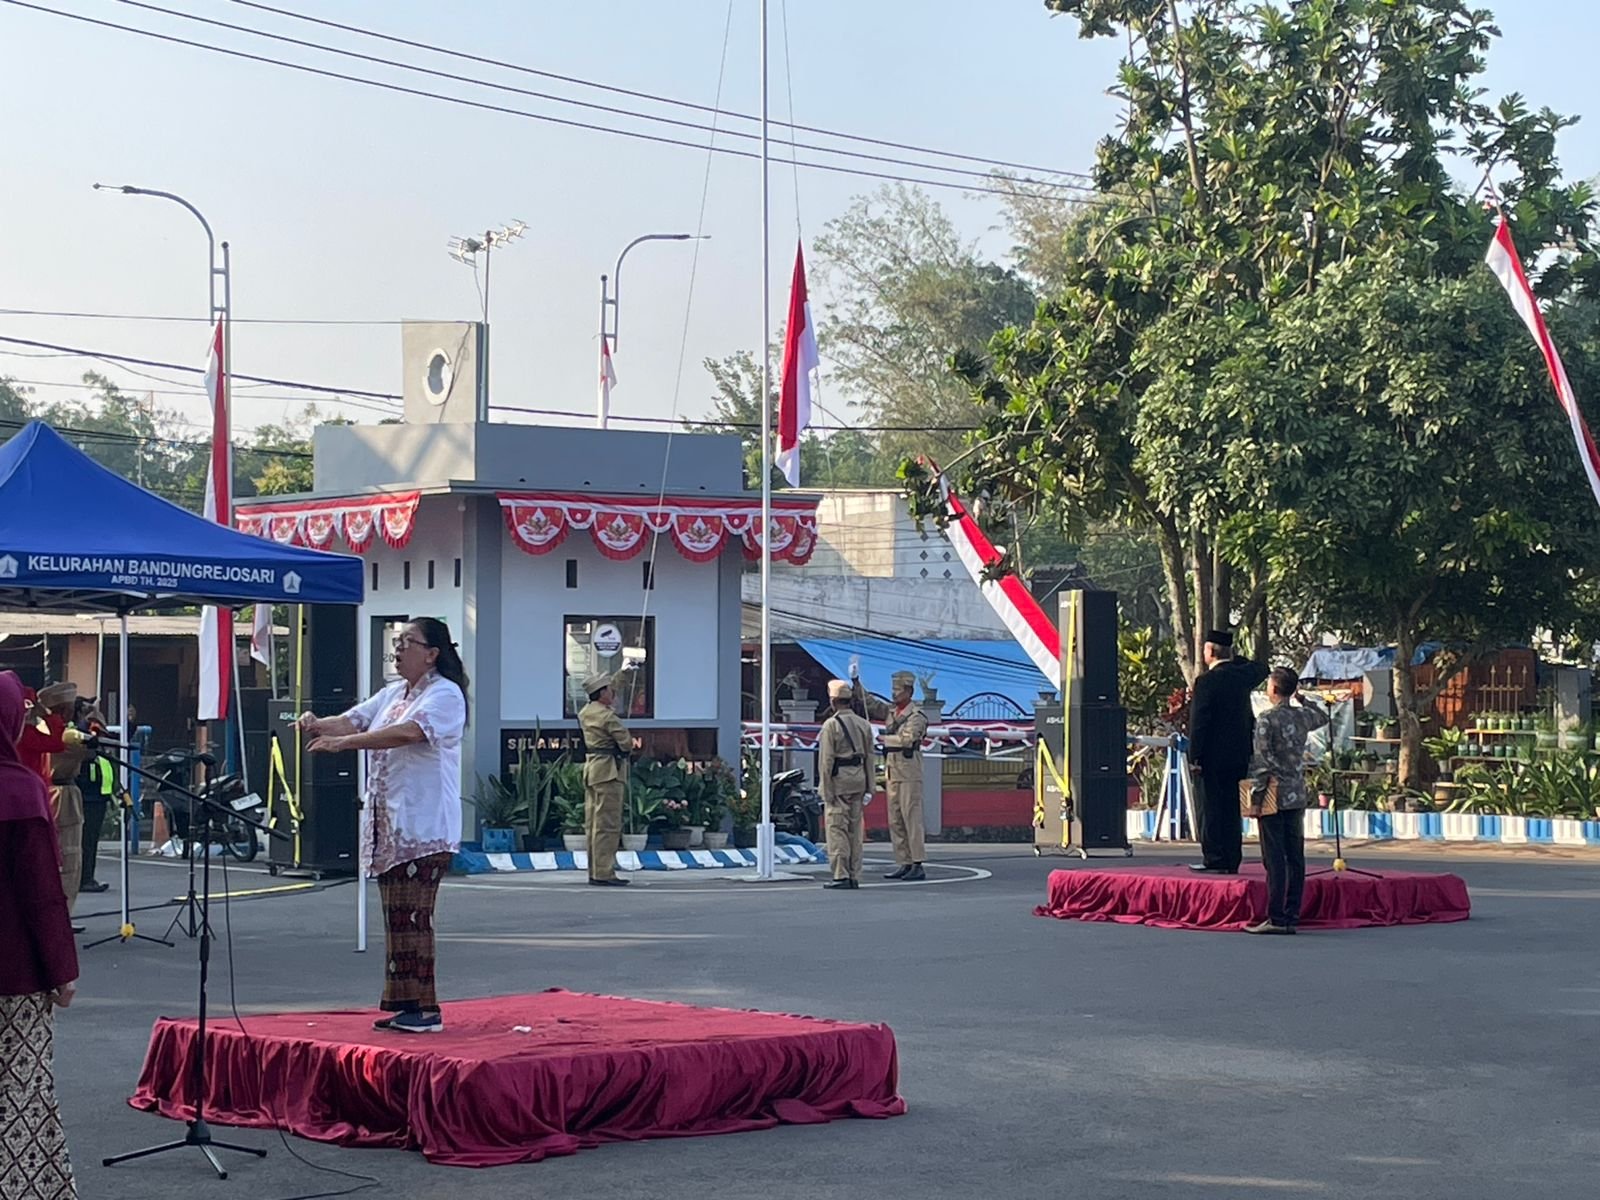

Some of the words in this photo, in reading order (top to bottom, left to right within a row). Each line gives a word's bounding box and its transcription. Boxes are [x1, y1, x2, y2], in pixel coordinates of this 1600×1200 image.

[28, 555, 125, 573] KELURAHAN
[128, 560, 275, 583] BANDUNGREJOSARI
[111, 575, 138, 585] APBD
[140, 576, 155, 586] TH.
[156, 577, 178, 588] 2025
